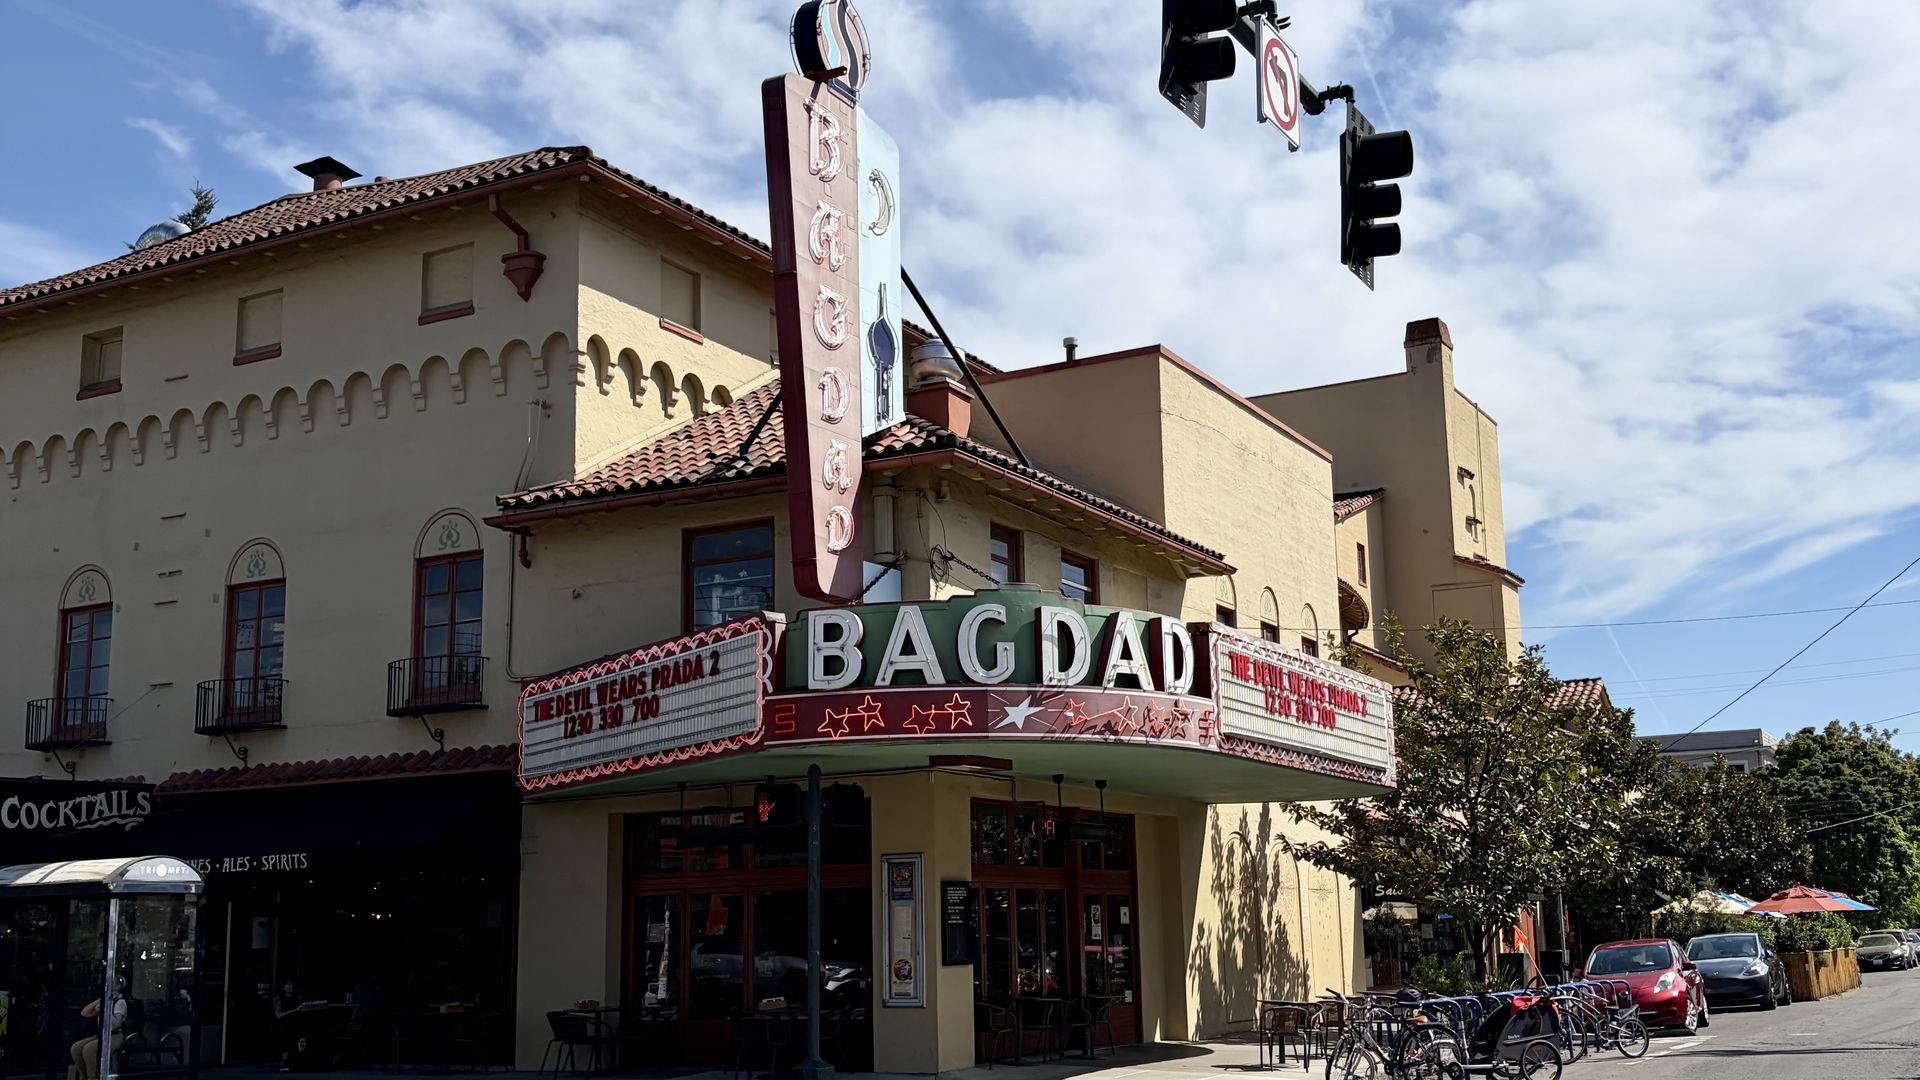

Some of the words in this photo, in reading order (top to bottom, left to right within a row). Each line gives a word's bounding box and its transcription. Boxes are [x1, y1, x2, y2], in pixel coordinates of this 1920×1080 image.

[803, 97, 855, 555] BAGDAD
[807, 603, 1195, 695] BAGDAD
[555, 687, 593, 718] DEVIL
[596, 671, 647, 706] WEARS
[651, 654, 705, 692] PRADA
[709, 650, 720, 676] 2
[1228, 651, 1251, 683] THE
[1253, 659, 1286, 693] DEVIL
[1288, 670, 1326, 705] WEARS
[1328, 684, 1360, 716] PRADA
[1361, 694, 1368, 718] 2
[563, 711, 593, 739] 1230
[599, 703, 623, 731] 330
[632, 694, 660, 724] 700
[1317, 702, 1336, 730] 700
[1, 789, 151, 830] COCKTAILS
[141, 866, 155, 874] TRI
[168, 866, 186, 874] MET
[222, 857, 250, 873] ALES
[261, 853, 307, 871] SPIRITS
